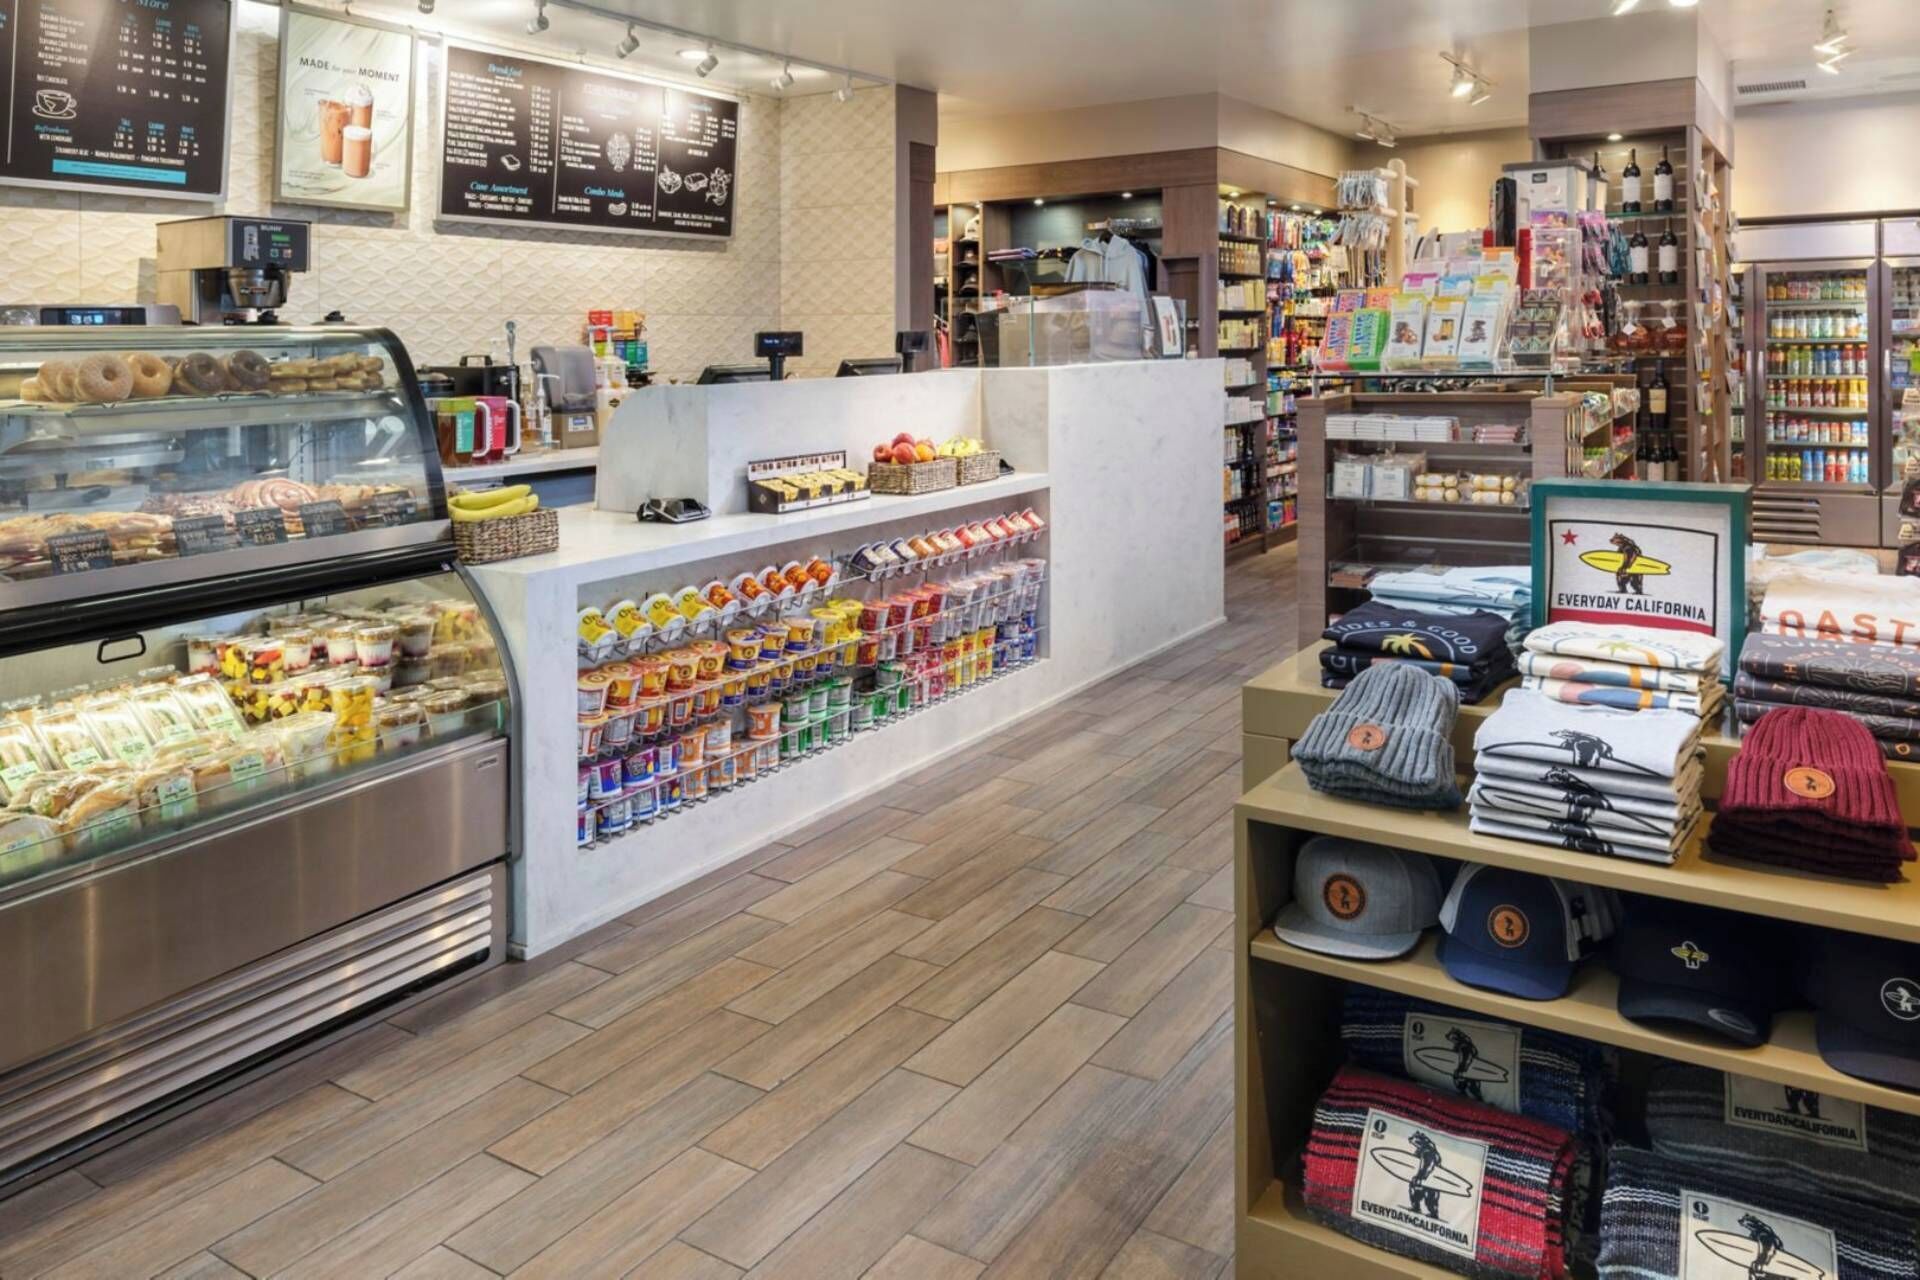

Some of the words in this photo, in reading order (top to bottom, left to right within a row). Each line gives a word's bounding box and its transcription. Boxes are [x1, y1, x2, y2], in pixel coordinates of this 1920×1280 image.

[299, 57, 329, 71] MADE
[358, 67, 400, 82] MOMENT
[1557, 592, 1621, 611] EVERYDAY
[1625, 598, 1707, 621] CALIFORNIA
[1328, 620, 1392, 634] TIDES
[1402, 620, 1417, 628] &
[1426, 625, 1479, 655] GOOD
[1733, 1106, 1789, 1126] EVERYDAY
[1791, 1118, 1857, 1141] CALIFORNIA
[1360, 1200, 1410, 1224] EVERYDAY
[1412, 1216, 1469, 1245] CALIFORNIA
